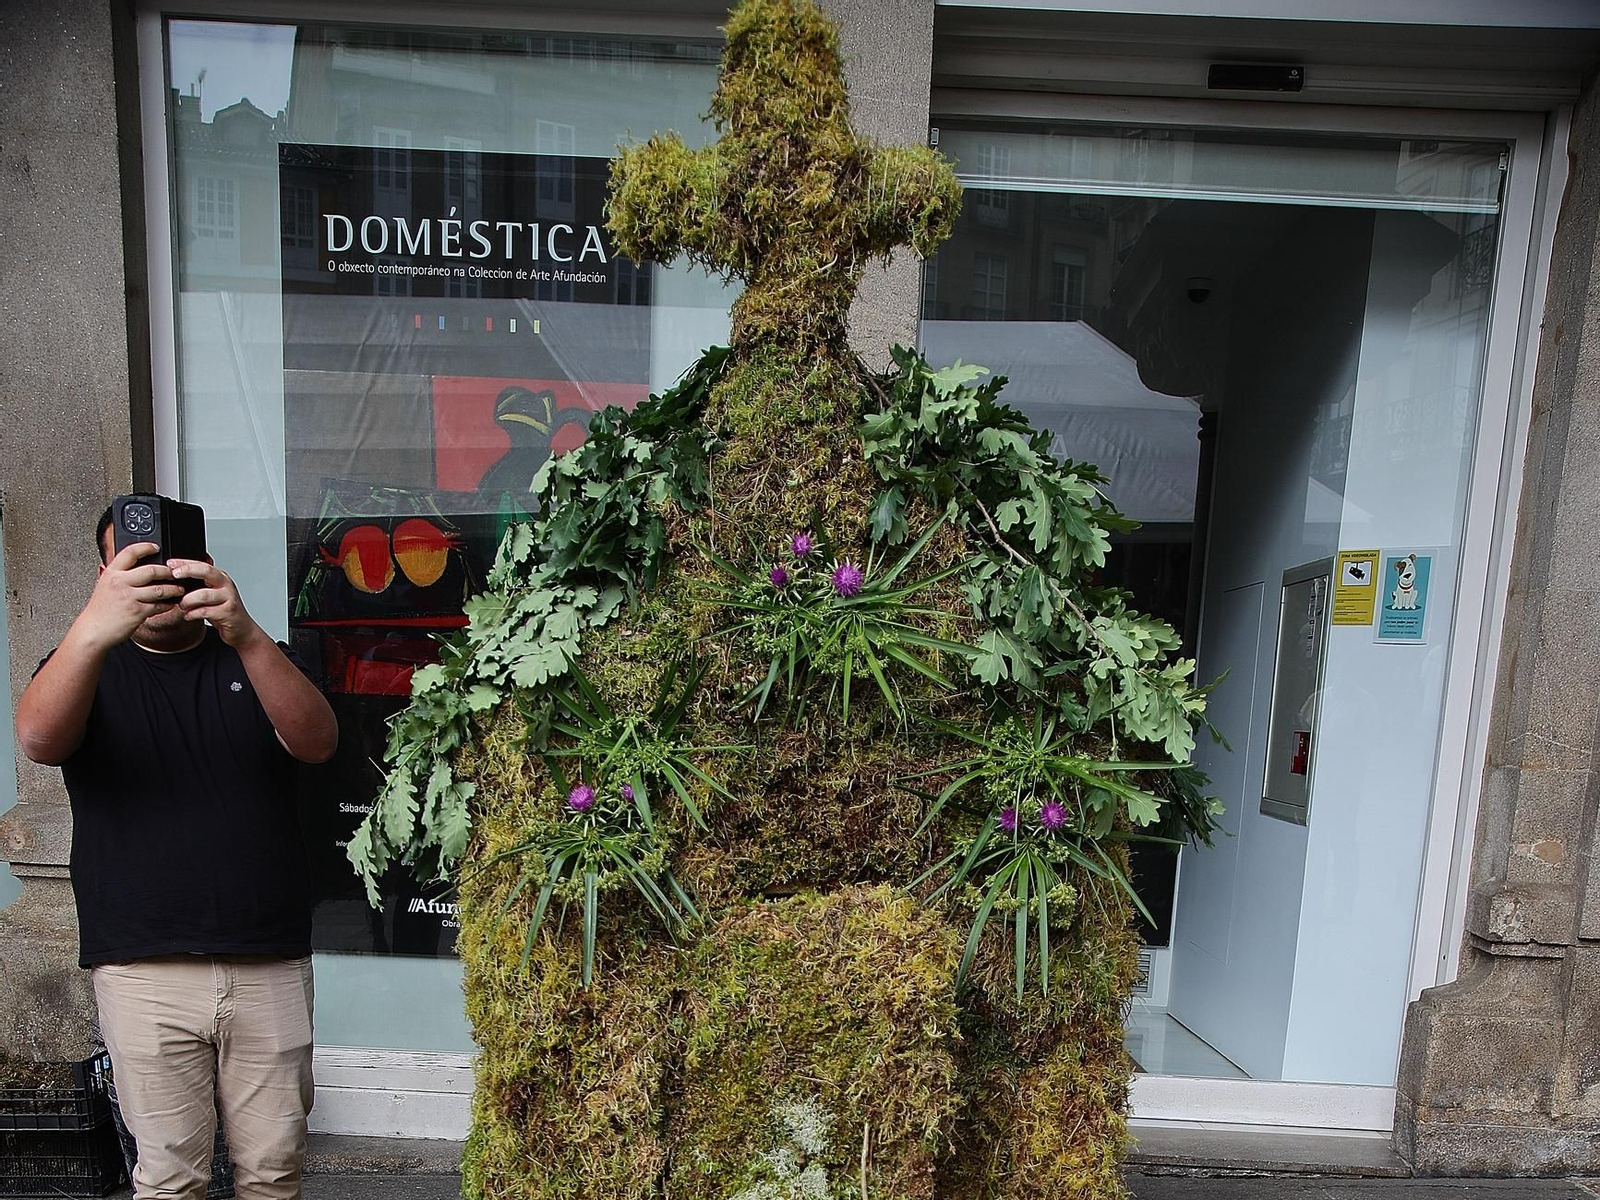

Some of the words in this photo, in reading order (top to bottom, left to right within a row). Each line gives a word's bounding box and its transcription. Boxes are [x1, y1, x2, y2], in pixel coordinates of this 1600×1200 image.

[322, 206, 608, 264] DOMÉSTICA
[327, 260, 336, 272] O
[338, 261, 375, 274] obxecto
[377, 263, 451, 279] contemporáneo
[453, 268, 465, 278] na
[515, 268, 528, 281] de
[529, 270, 551, 282] Arte
[553, 271, 607, 284] Afundación
[339, 802, 375, 814] Sábados
[441, 919, 460, 928] Obra
